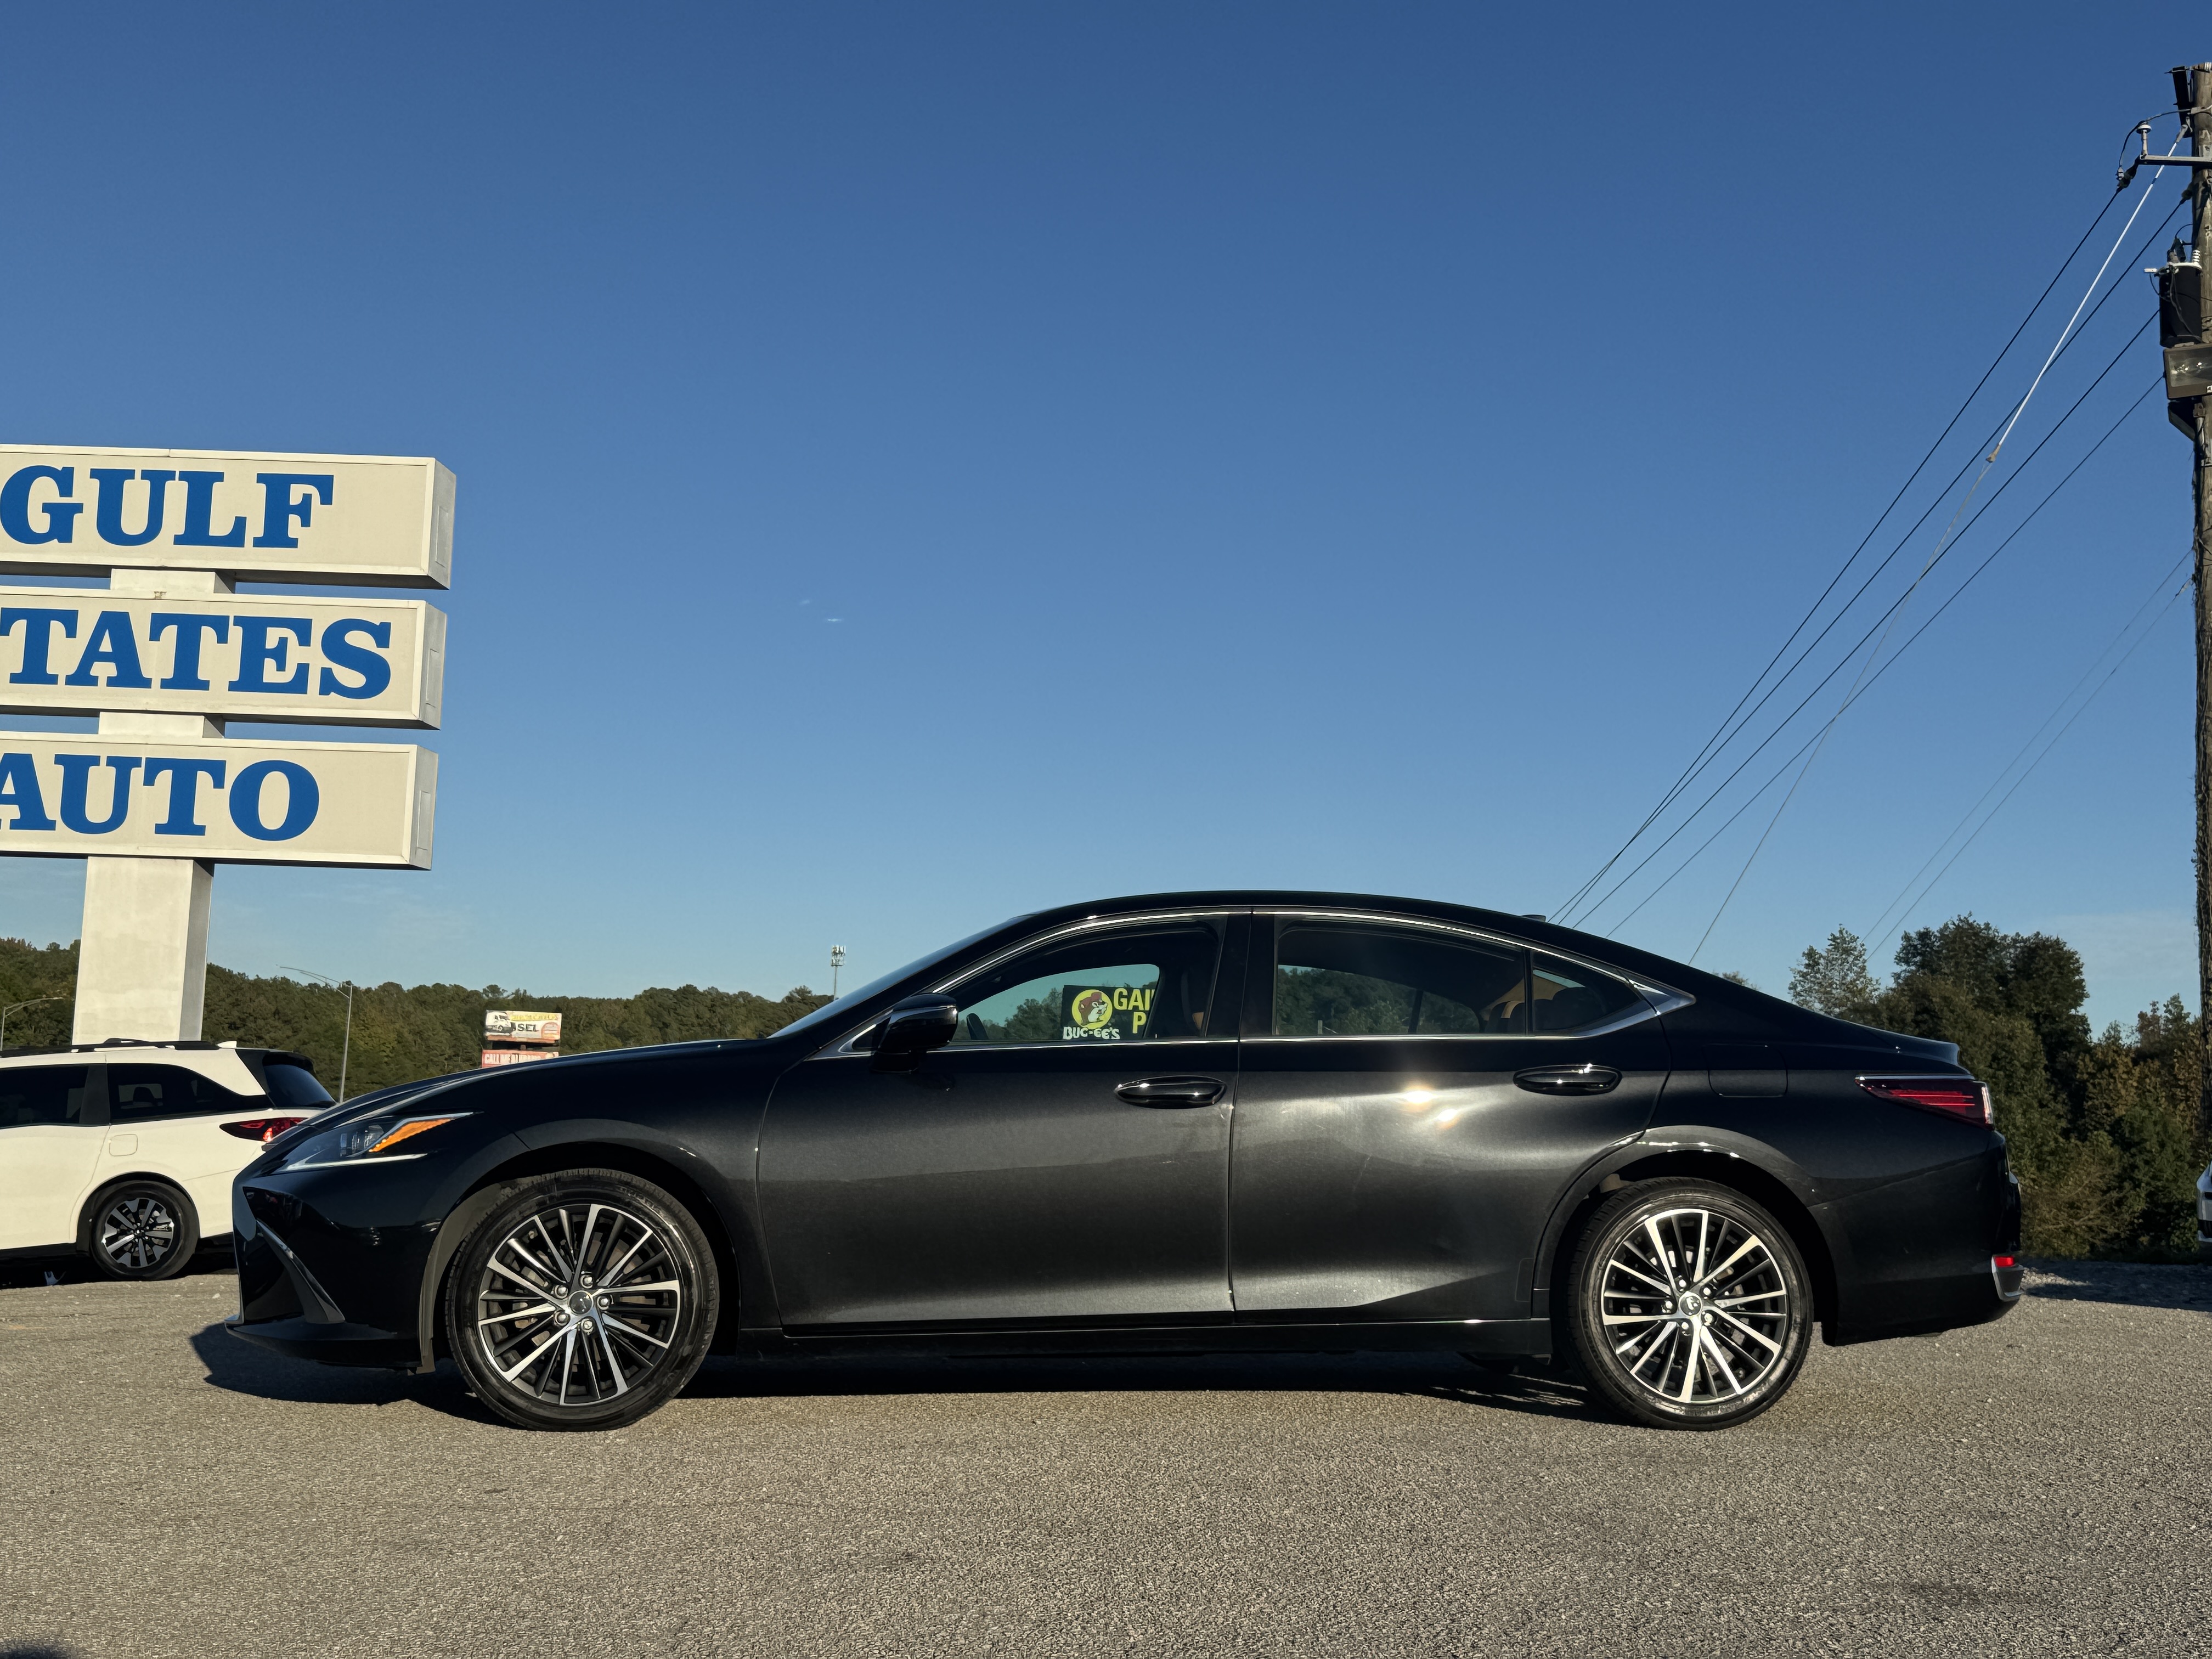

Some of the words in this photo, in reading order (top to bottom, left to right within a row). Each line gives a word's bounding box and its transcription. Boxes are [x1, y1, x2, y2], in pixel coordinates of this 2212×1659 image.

[1, 465, 334, 549] GULF
[0, 607, 391, 699] TATES
[0, 753, 319, 842] AUTO
[1114, 988, 1155, 1011] GAI
